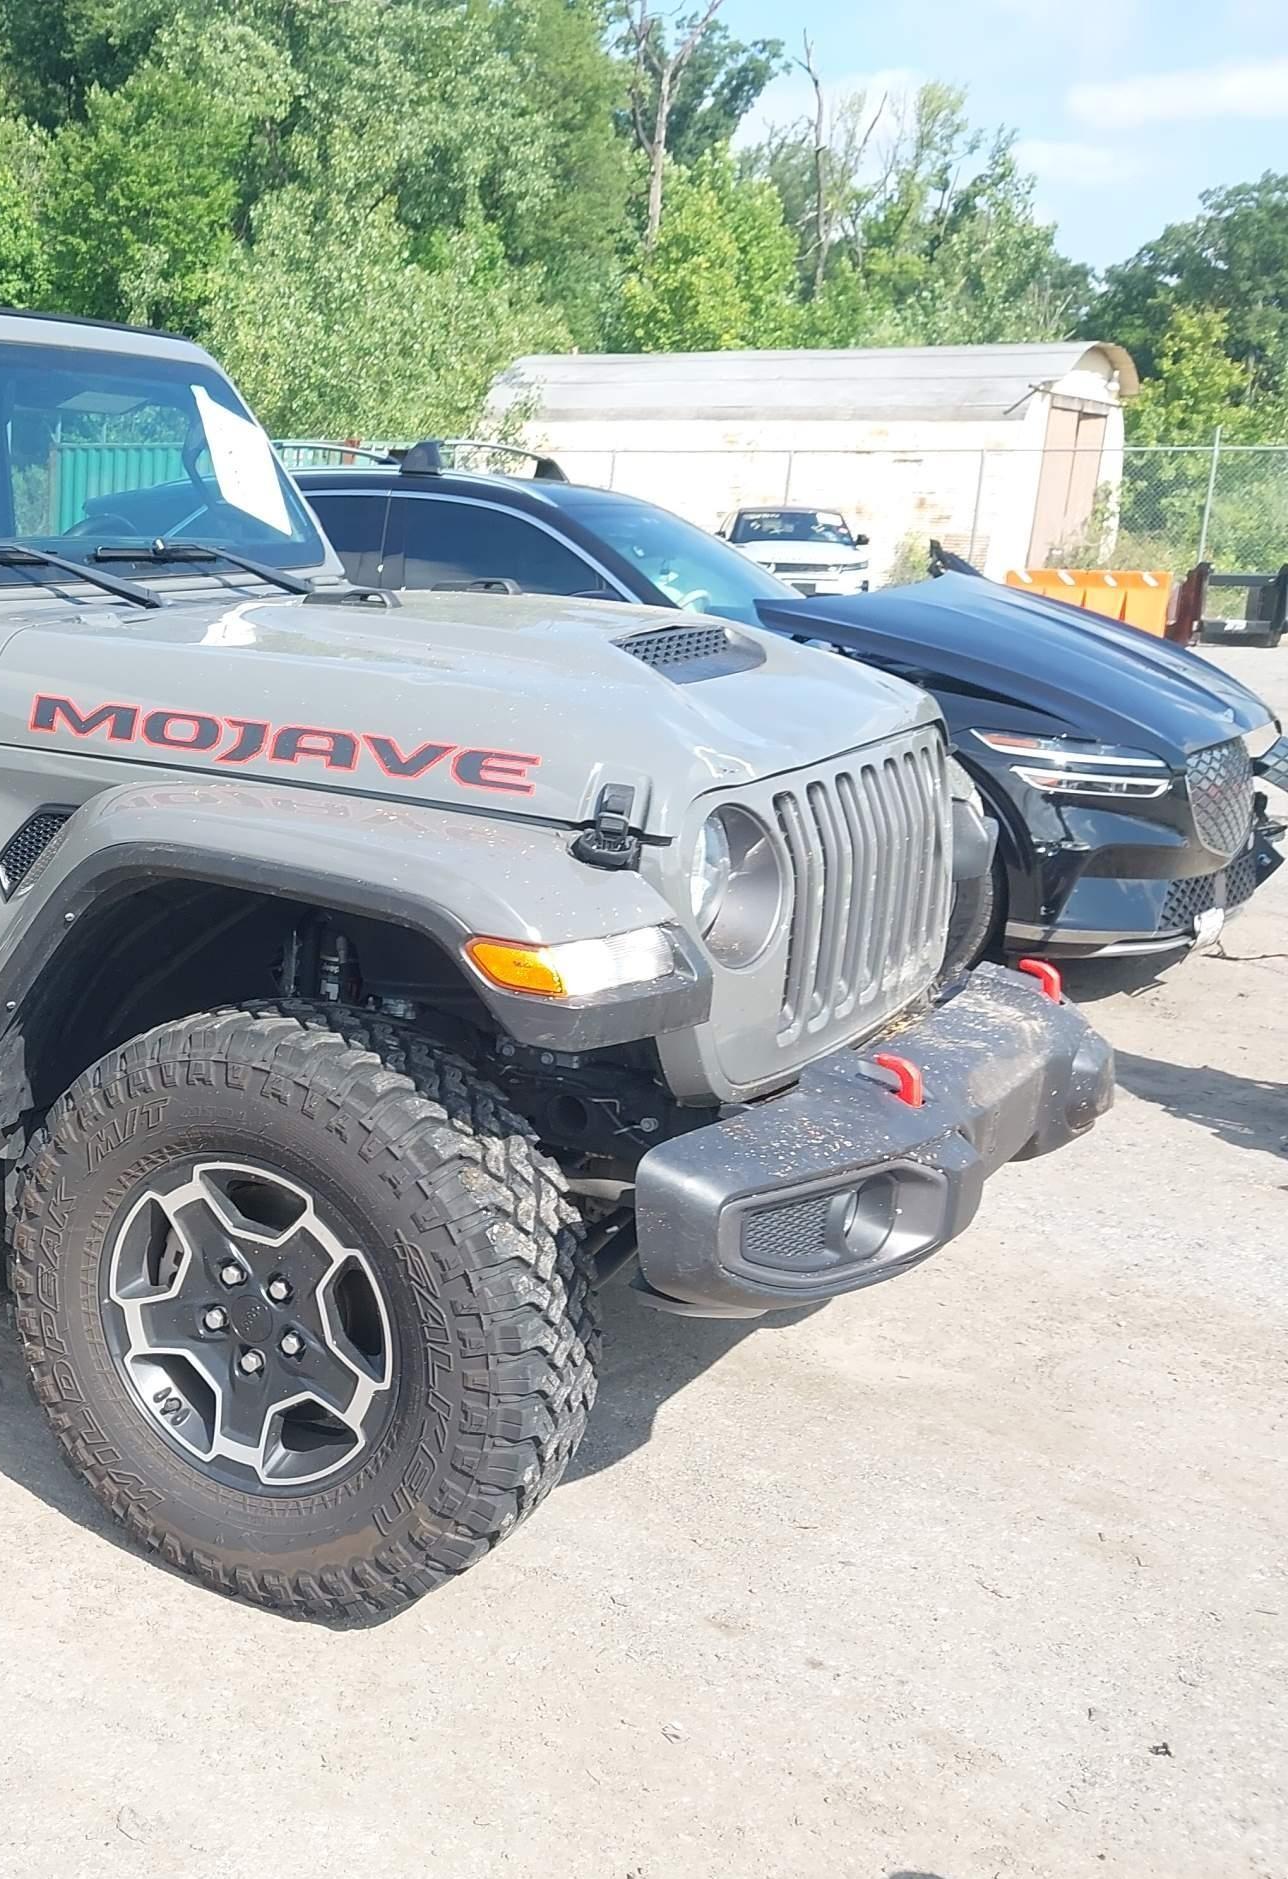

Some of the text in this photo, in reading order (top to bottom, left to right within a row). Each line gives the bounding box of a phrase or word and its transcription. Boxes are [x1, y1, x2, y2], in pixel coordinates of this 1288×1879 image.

[28, 693, 542, 797] MOJAVE
[38, 1096, 171, 1513] WILDPEAK M/T
[371, 1229, 454, 1538] FALKEN
